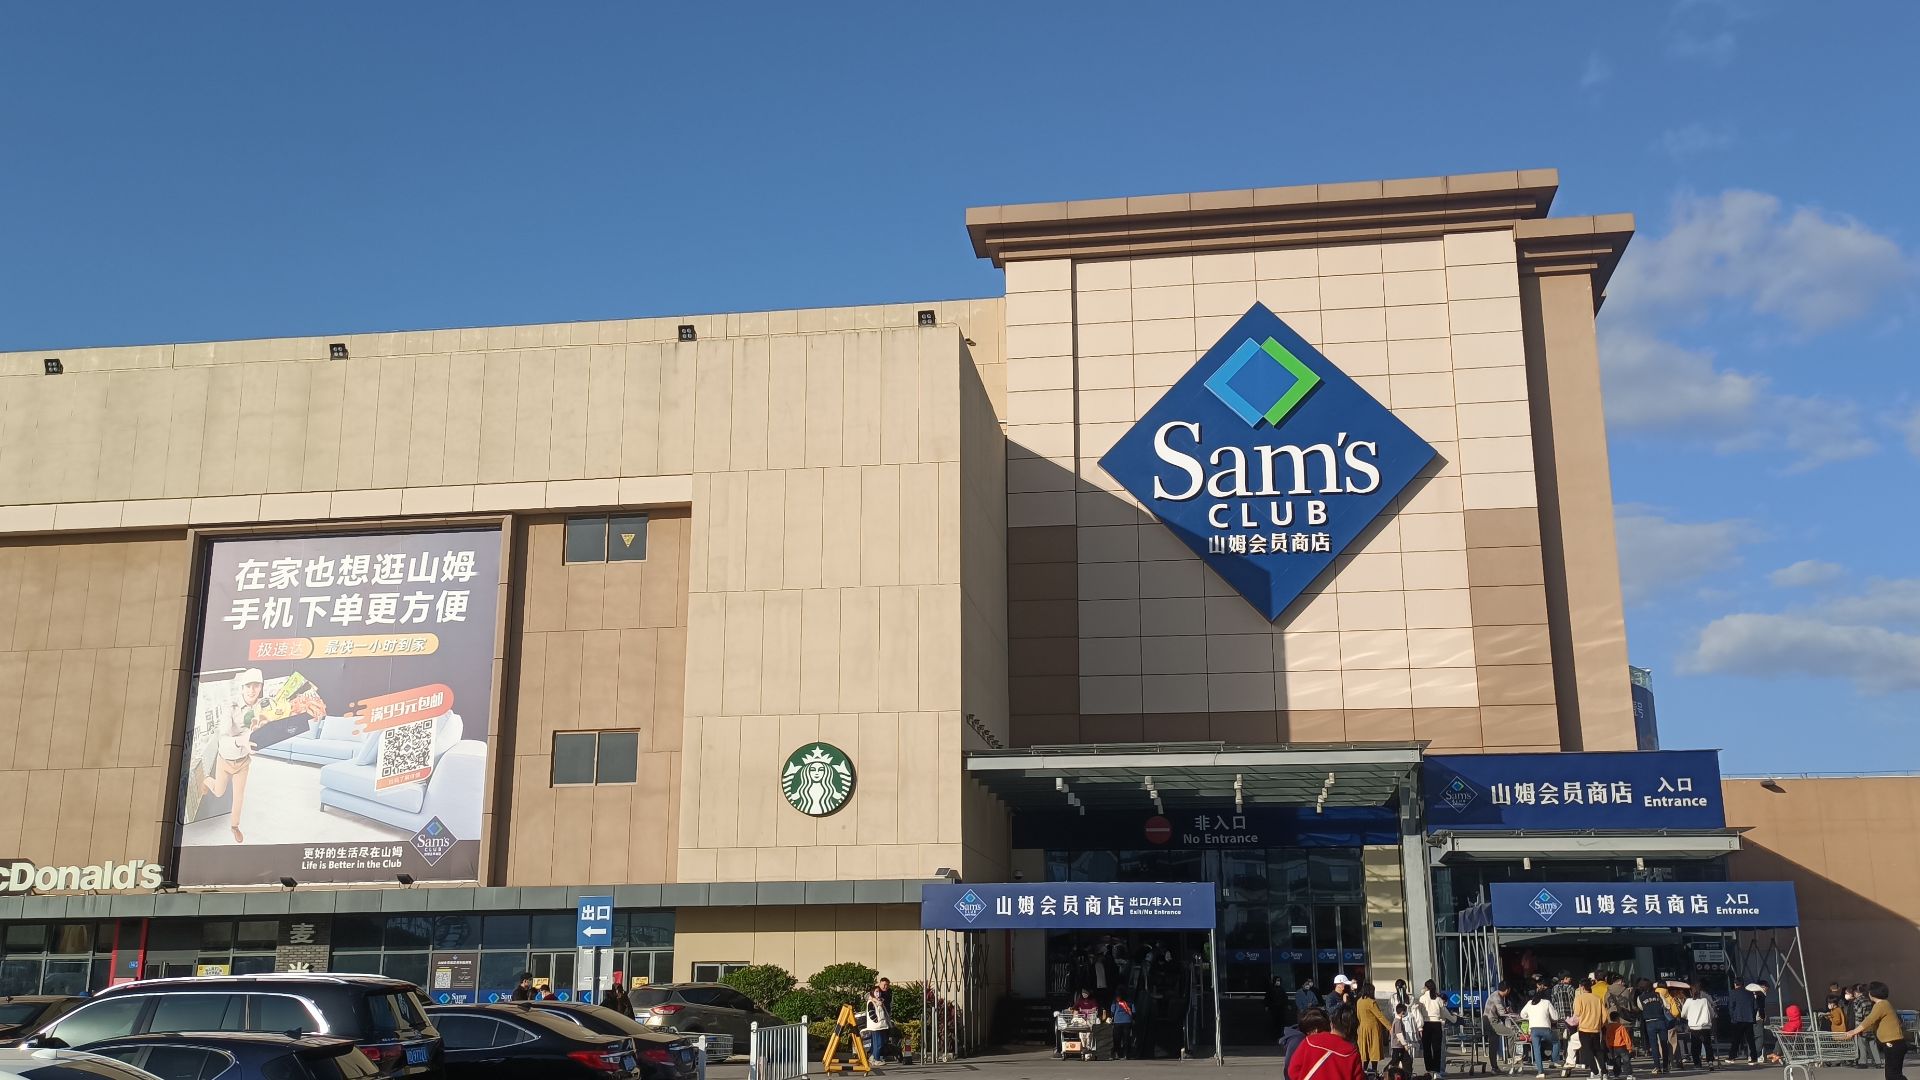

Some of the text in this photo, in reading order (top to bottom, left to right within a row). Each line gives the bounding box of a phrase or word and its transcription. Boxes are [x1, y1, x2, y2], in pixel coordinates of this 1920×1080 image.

[1153, 421, 1381, 500] Sam's
[1208, 500, 1328, 528] CLUB
[1208, 532, 1331, 554] 山姆会员商店
[235, 550, 477, 591] 在家也想逛山姆
[223, 589, 470, 630] 手机下单更方便
[325, 638, 427, 655] 最快一小时到家
[371, 691, 443, 723] 满99元包邮
[1658, 777, 1692, 792] 入口
[1491, 781, 1632, 805] 山姆会员商店
[1643, 795, 1707, 807] Entrance
[1194, 815, 1246, 830] 非入口
[417, 834, 450, 848] Sam's
[1183, 833, 1259, 844] No Entrance
[303, 846, 403, 860] 更好的生活尽在山姆
[301, 859, 402, 870] Life is Better in the Club
[959, 902, 981, 911] Sam's
[996, 895, 1124, 916] 山姆会员商店
[1129, 896, 1182, 906] 出口/非入口
[1575, 894, 1709, 915] 山姆会员商店
[1725, 893, 1749, 905] 入口
[581, 904, 611, 921] 出口
[1716, 906, 1760, 915] Entrance
